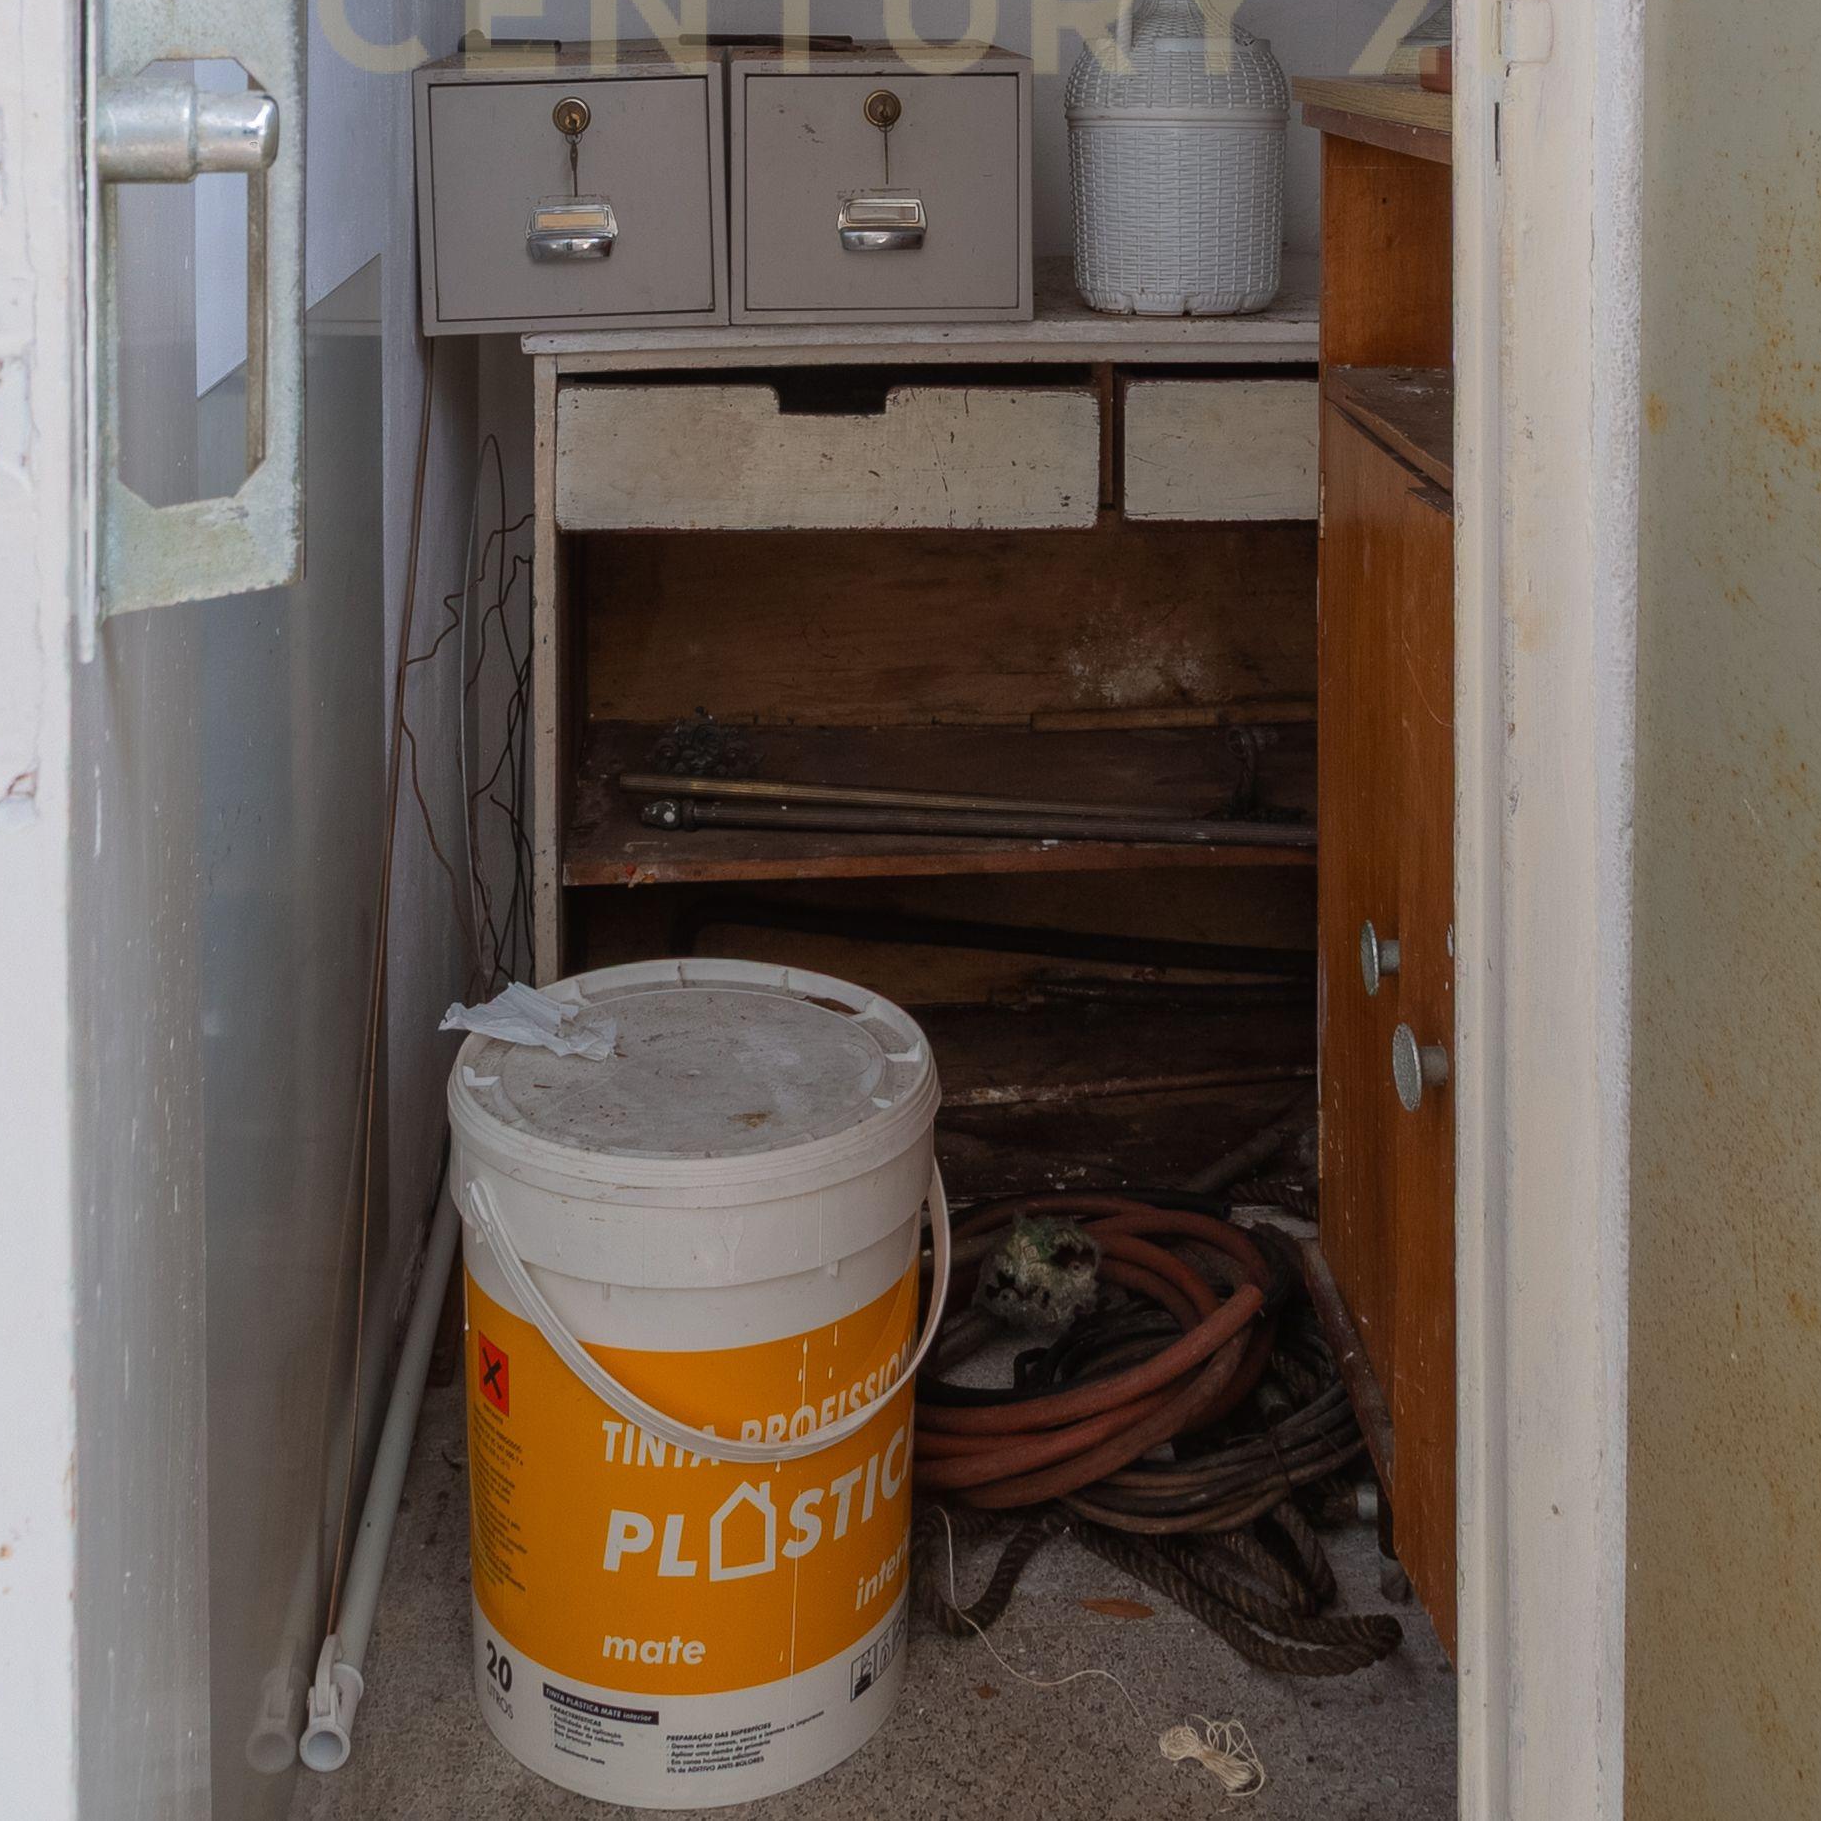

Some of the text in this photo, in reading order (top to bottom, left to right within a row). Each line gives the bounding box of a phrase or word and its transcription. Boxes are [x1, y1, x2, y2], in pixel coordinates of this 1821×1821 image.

[486, 1638, 513, 1693] 20
[601, 1634, 707, 1666] mate
[545, 1688, 565, 1703] TINTA
[600, 1707, 621, 1719] MATE
